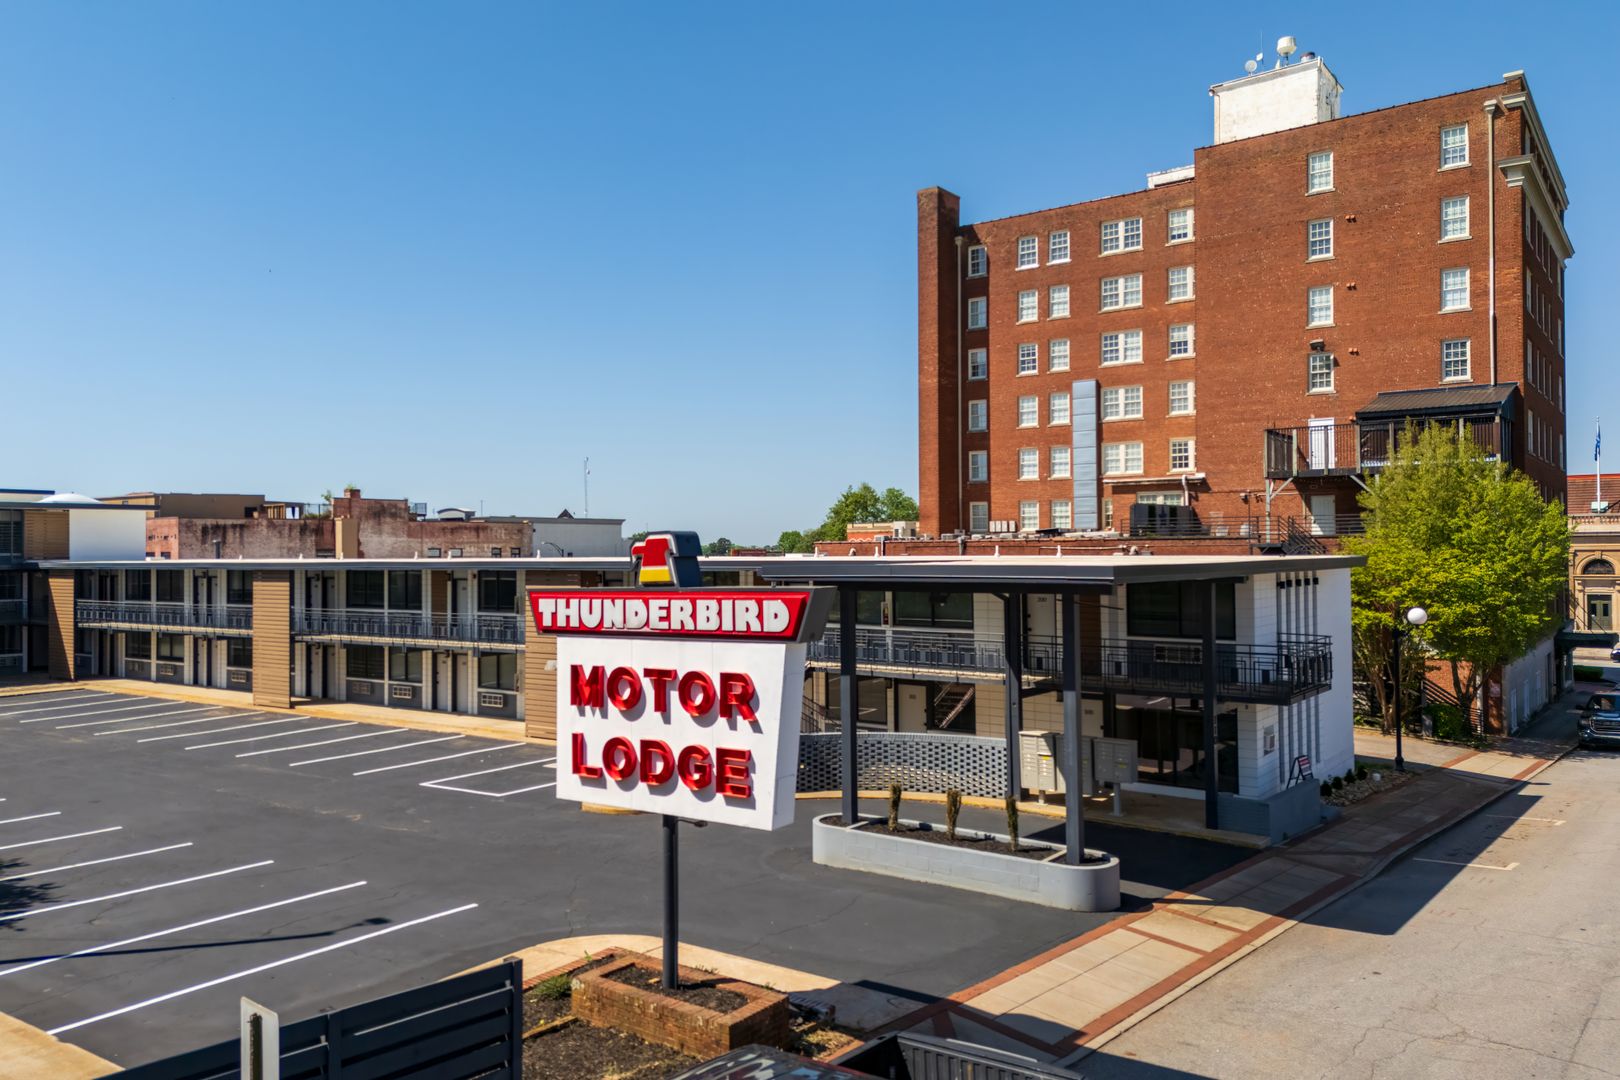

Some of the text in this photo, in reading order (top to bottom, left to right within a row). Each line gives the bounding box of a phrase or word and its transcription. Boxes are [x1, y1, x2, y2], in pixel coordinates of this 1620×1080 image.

[538, 598, 790, 632] THUNDERBIRD
[570, 664, 757, 721] MOTOR
[571, 732, 751, 799] LODGE
